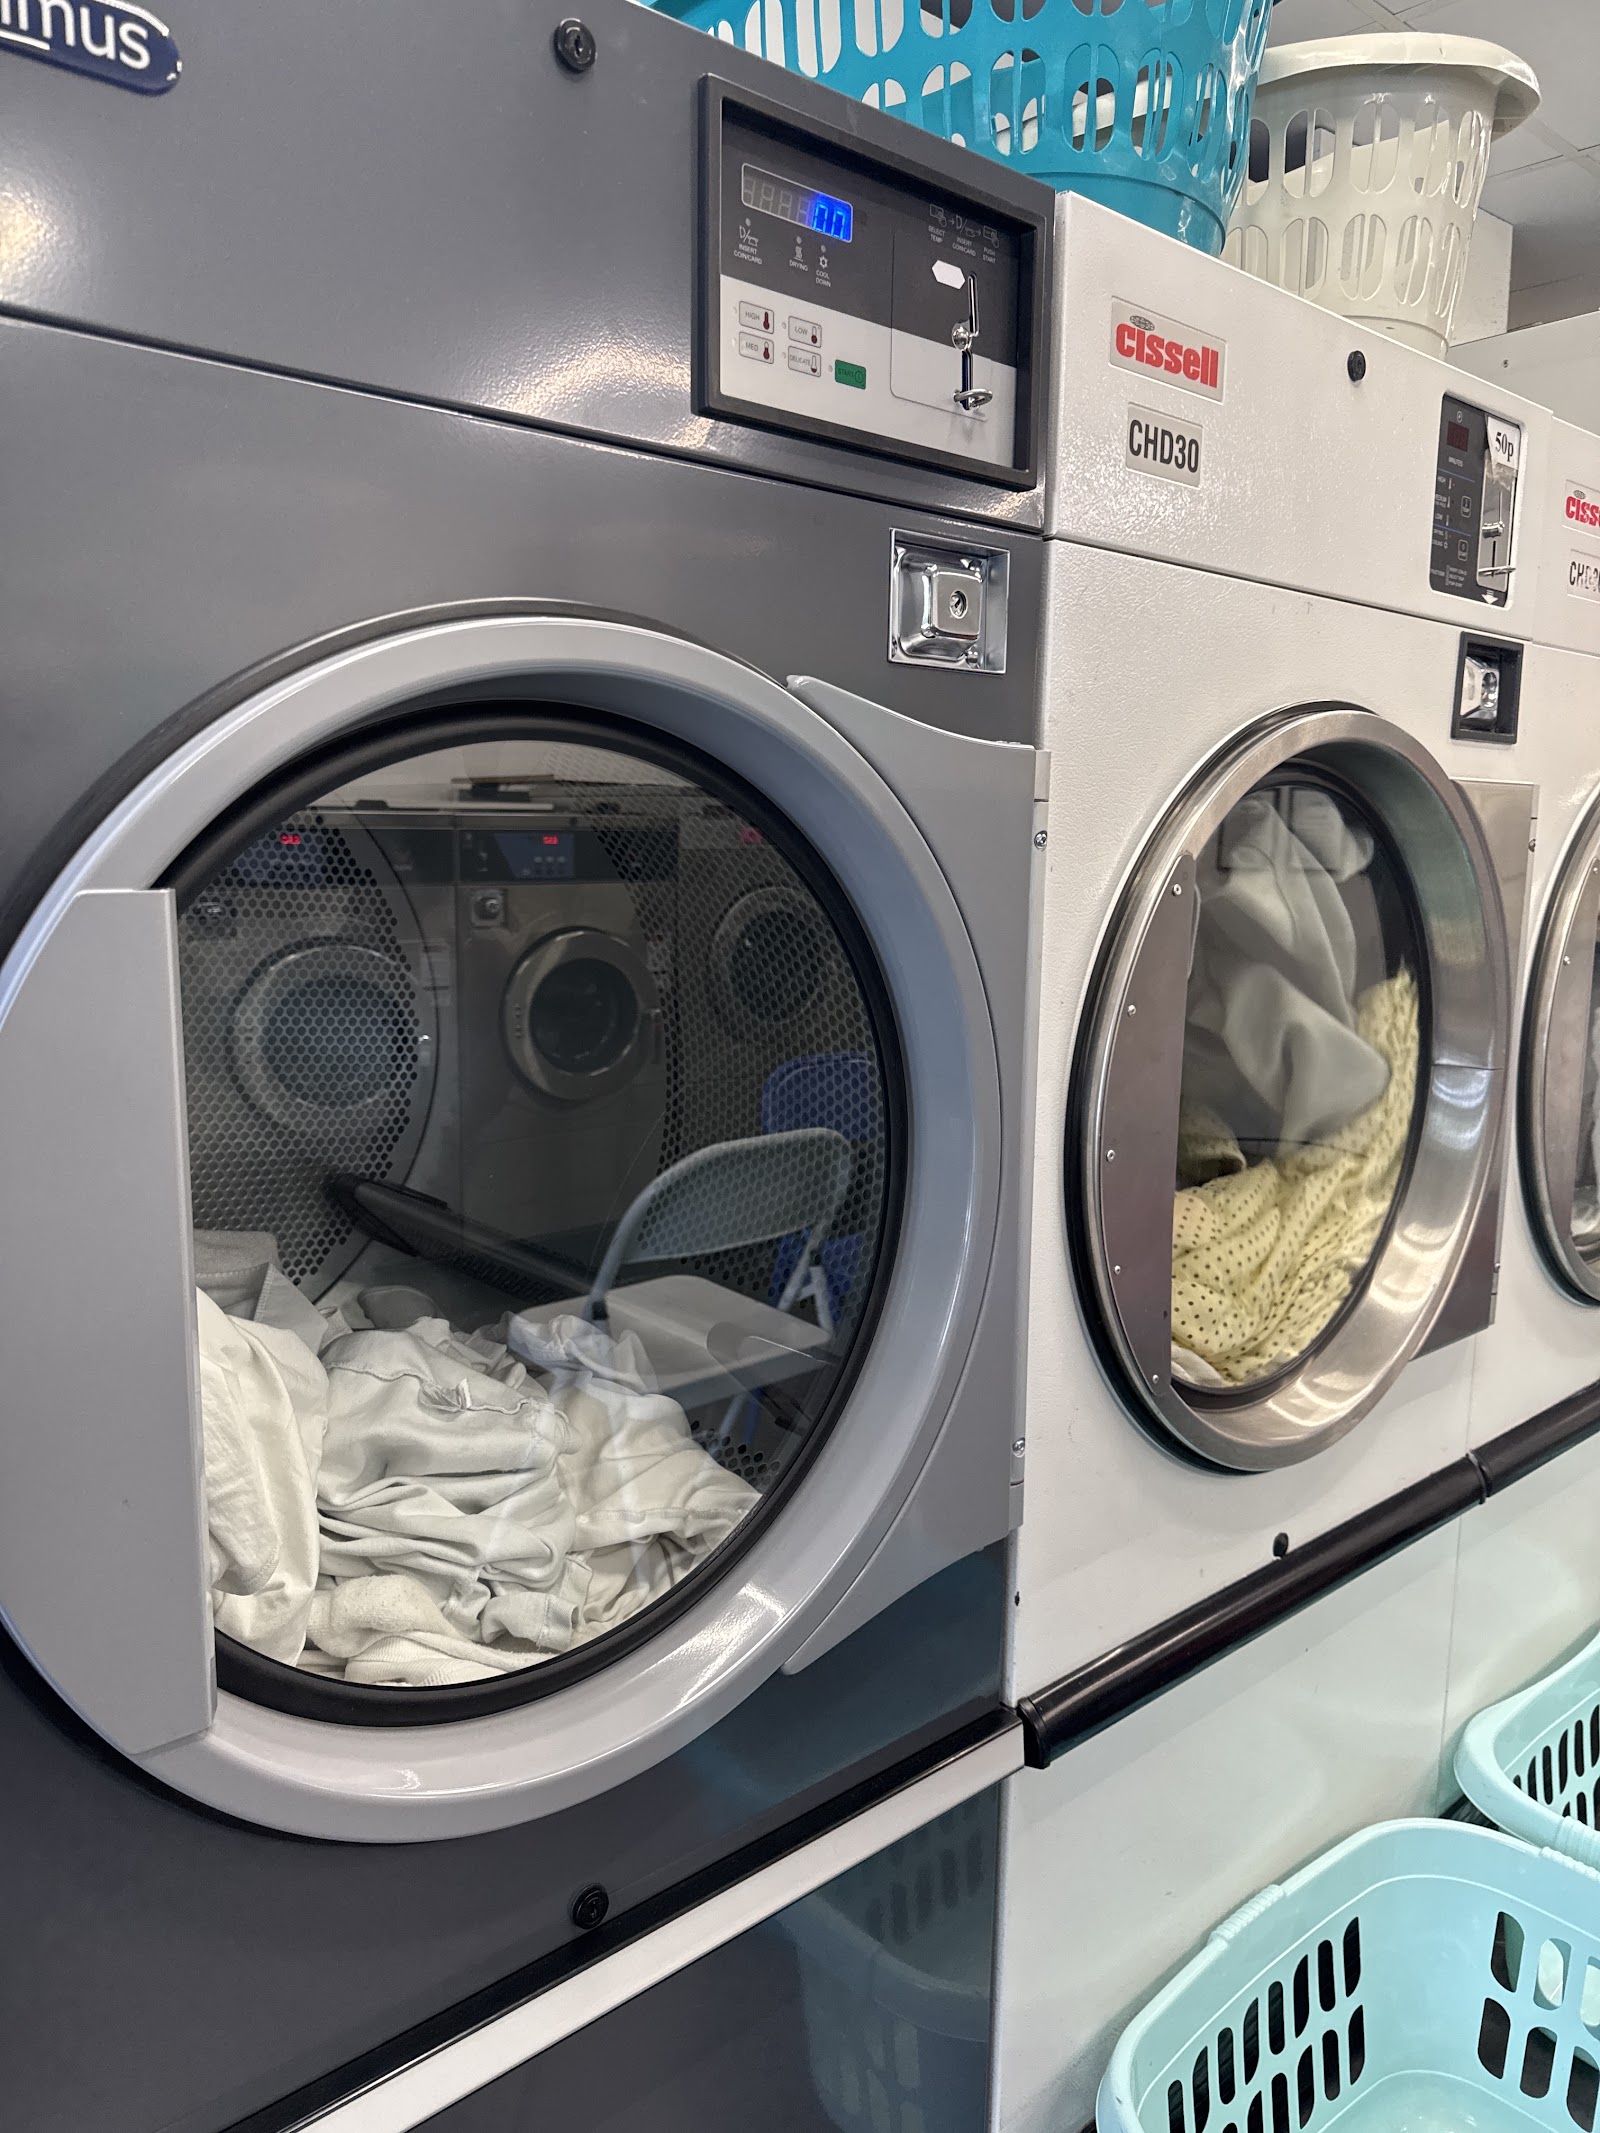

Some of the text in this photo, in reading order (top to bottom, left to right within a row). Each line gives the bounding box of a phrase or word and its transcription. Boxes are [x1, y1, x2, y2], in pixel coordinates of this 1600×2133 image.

[739, 244, 758, 255] INSERT
[789, 260, 808, 272] DRYING
[816, 269, 830, 279] COOL
[815, 278, 831, 288] DOWN
[745, 311, 760, 321] HIGH
[794, 326, 808, 336] LOW
[745, 342, 759, 352] MED
[789, 354, 811, 367] DELICATE
[838, 368, 854, 378] START
[1129, 419, 1199, 473] CHD30
[1495, 431, 1514, 462] 50p
[1565, 496, 1600, 527] ciss
